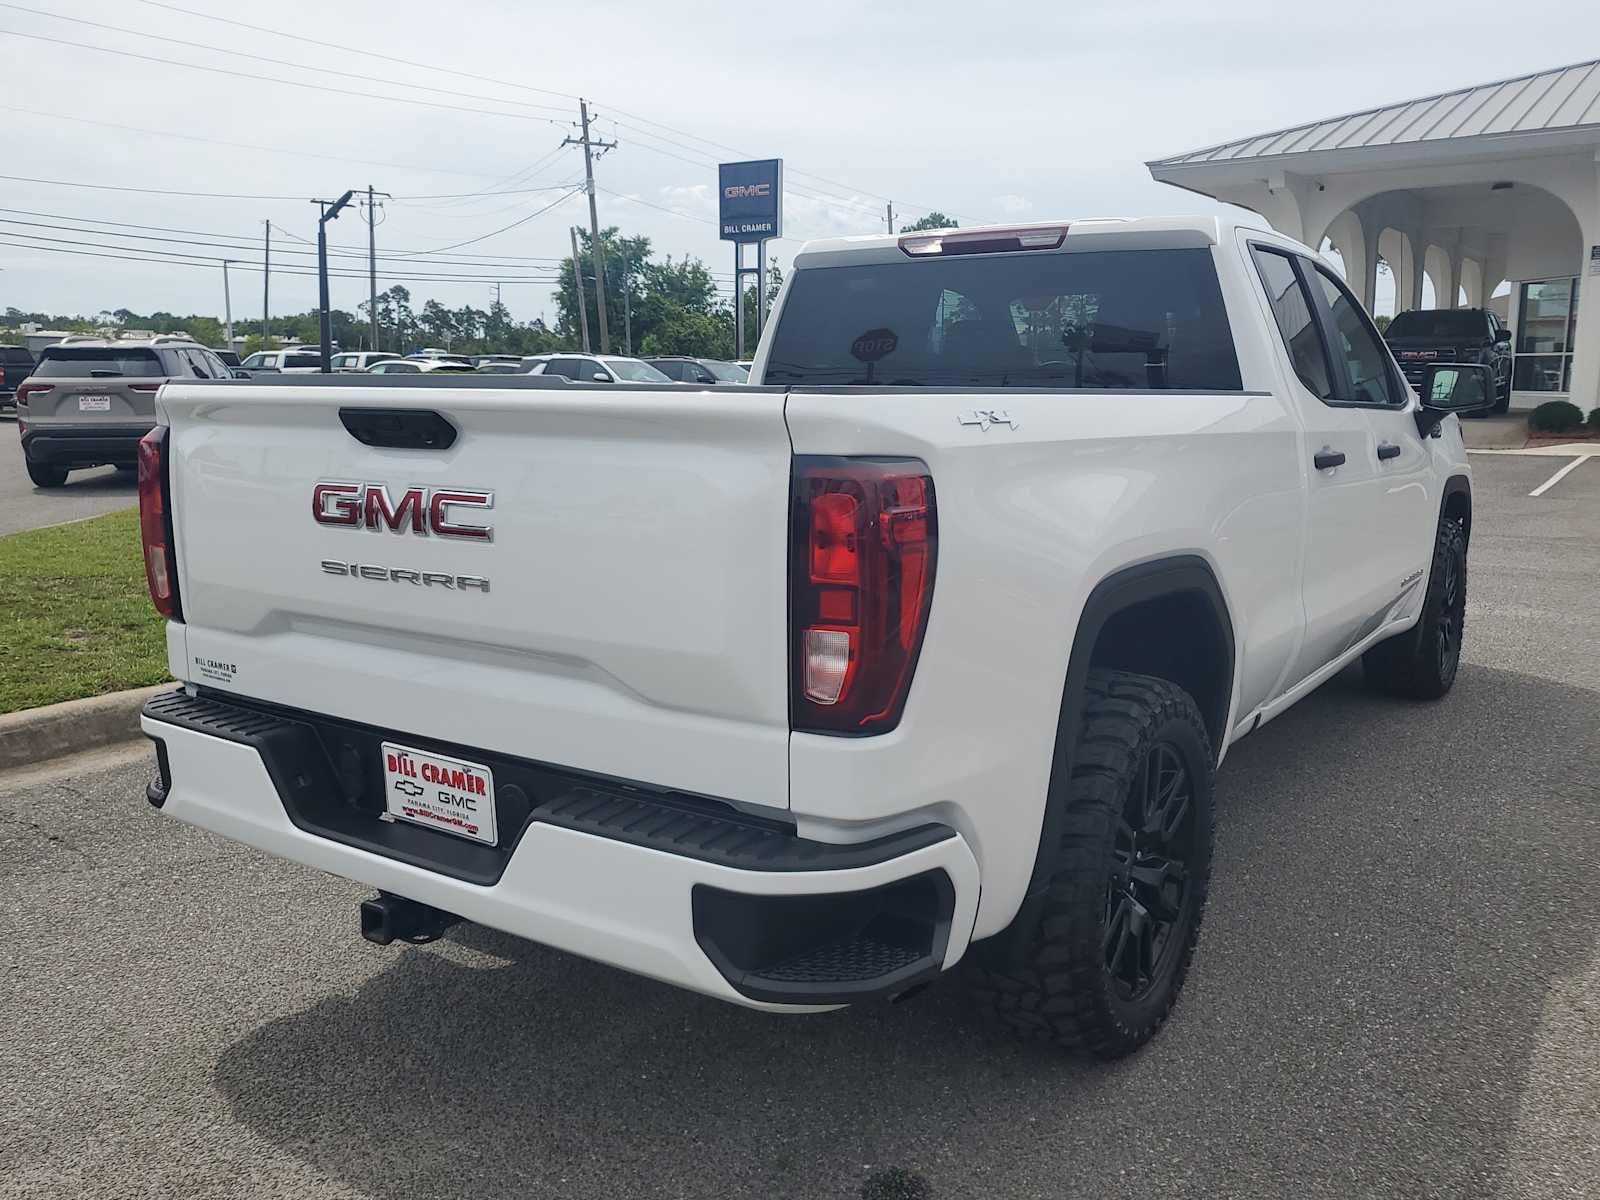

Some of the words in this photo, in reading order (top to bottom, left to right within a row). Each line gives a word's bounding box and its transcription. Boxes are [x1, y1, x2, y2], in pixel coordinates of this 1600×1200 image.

[725, 184, 770, 198] GMC
[724, 225, 739, 234] BILL
[741, 224, 771, 233] CRAMER
[312, 481, 495, 543] GMC
[320, 558, 492, 593] SIERRA
[195, 657, 206, 666] BILL
[387, 753, 417, 777] BILL
[421, 763, 486, 796] CRAMER
[407, 798, 430, 810] PANAMA
[438, 791, 477, 812] GMC
